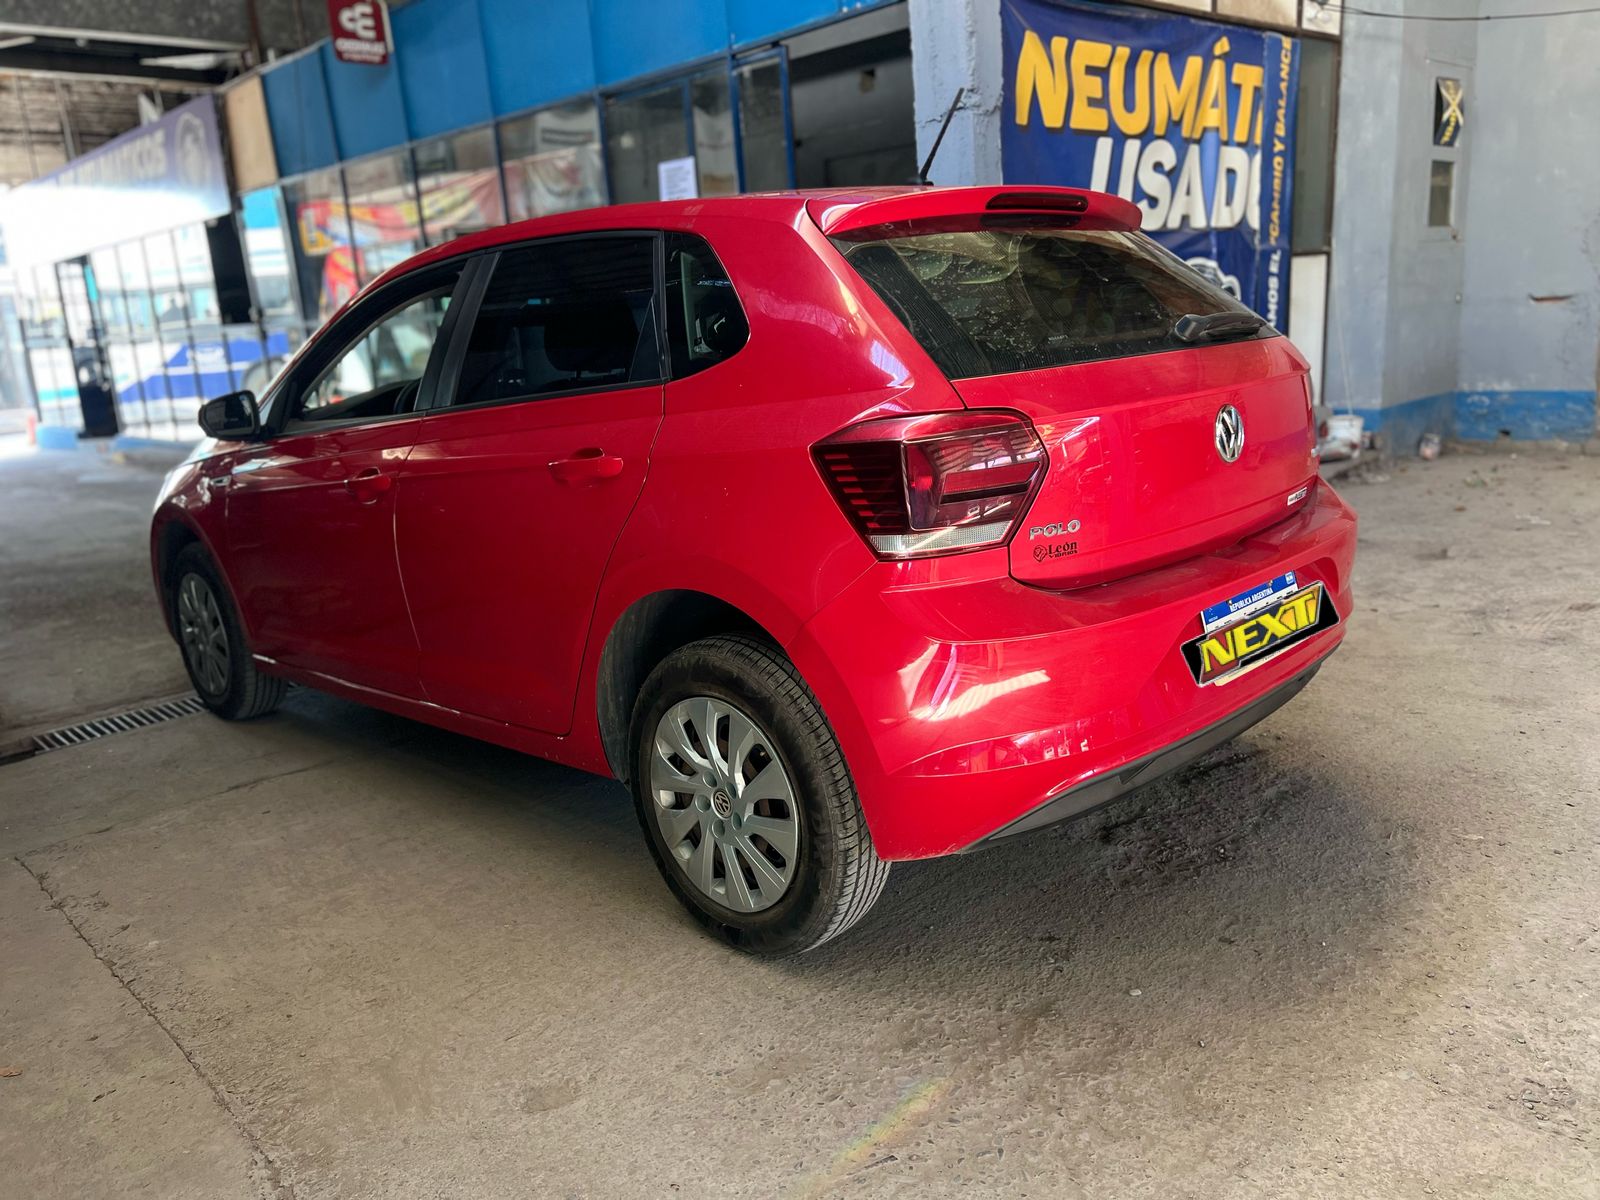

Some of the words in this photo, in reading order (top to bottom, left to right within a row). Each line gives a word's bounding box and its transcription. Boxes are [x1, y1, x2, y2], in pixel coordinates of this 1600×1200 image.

[1274, 142, 1286, 154] Y
[1029, 519, 1081, 541] POLO
[1251, 587, 1274, 602] ARGENTINA
